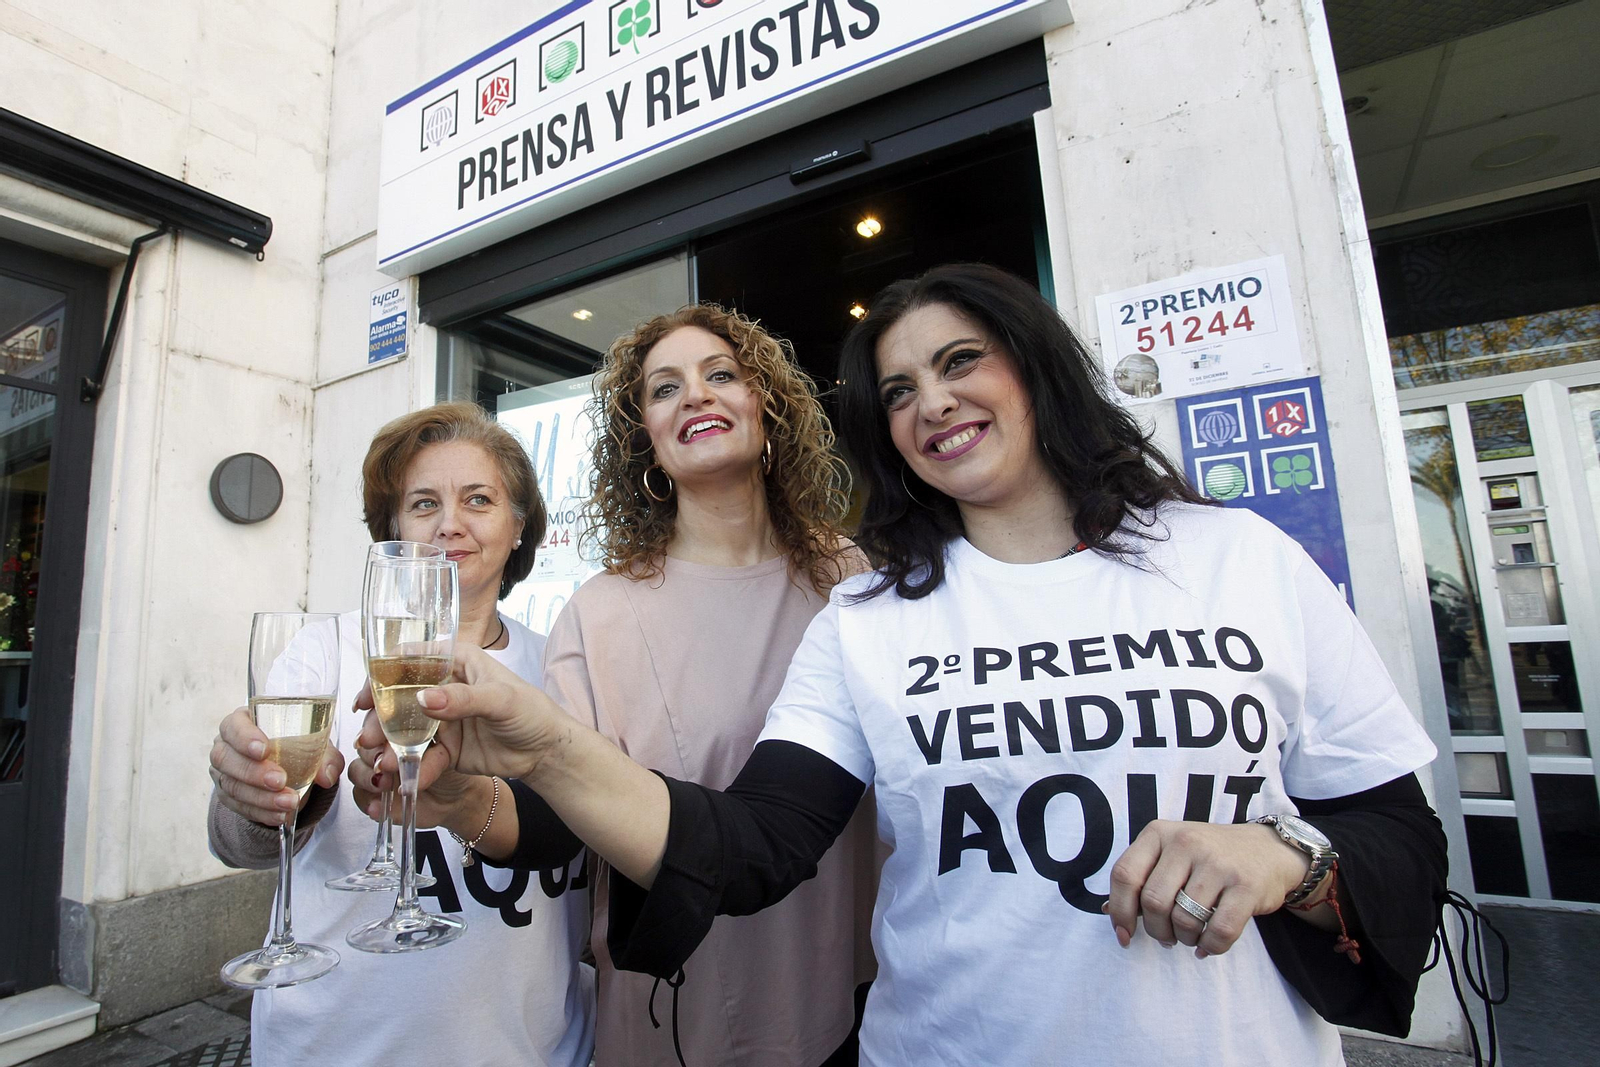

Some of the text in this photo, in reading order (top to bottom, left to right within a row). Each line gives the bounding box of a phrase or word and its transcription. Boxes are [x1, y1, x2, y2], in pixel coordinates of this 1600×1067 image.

[457, 0, 880, 210] PRENSA Y REVISTAS
[372, 288, 399, 306] tyco
[371, 320, 396, 335] Alarma
[1136, 305, 1255, 353] 51244
[381, 338, 393, 348] 444
[547, 510, 576, 527] MIO
[540, 528, 570, 549] 244
[973, 626, 1264, 686] PREMIO
[905, 688, 1268, 765] VENDIDO
